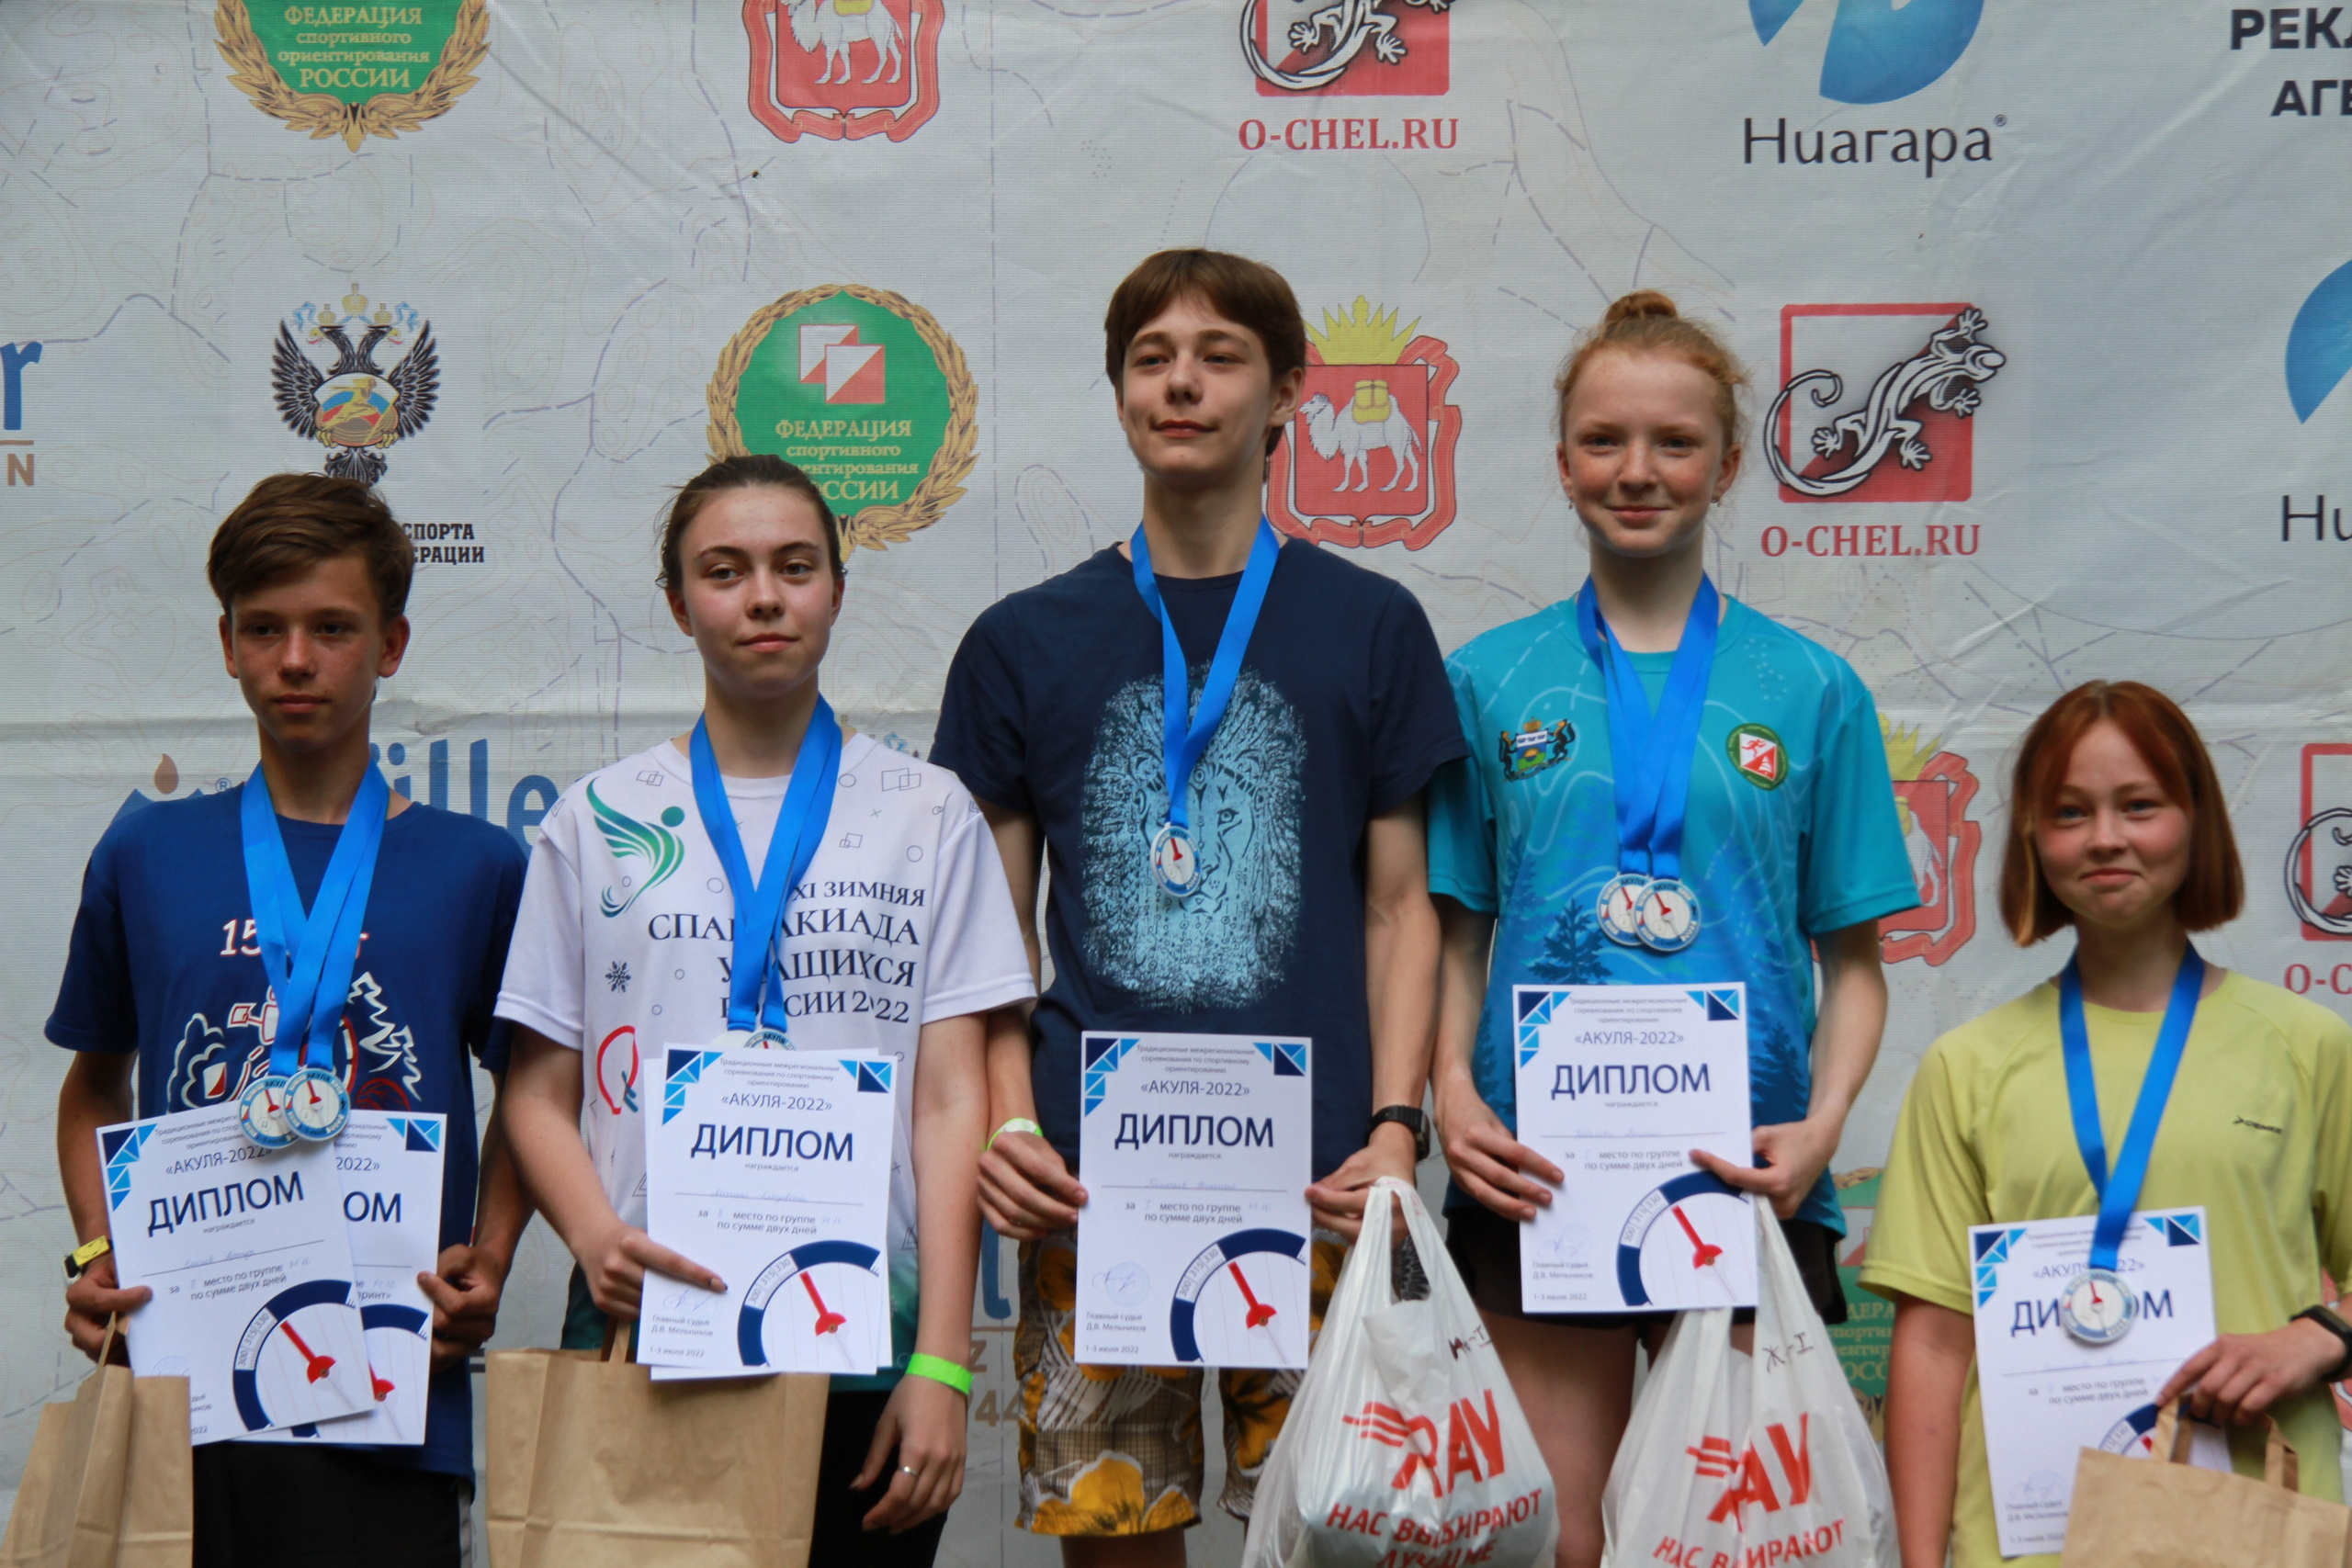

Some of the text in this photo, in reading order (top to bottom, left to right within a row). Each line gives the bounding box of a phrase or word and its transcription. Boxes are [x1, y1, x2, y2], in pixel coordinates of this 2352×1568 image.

[284, 6, 423, 28] ФЕДЕРАЦИЯ
[2230, 7, 2352, 50] РЕК
[295, 32, 412, 49] спортивного
[277, 49, 431, 65] ориентирования
[300, 68, 411, 89] РОССИИ
[1238, 118, 1459, 150] O-CHEL.RU
[1743, 118, 1994, 178] Ниагара
[775, 420, 912, 441] ФЕДЕРАЦИЯ
[786, 446, 901, 460] спортивного
[799, 463, 919, 479] ентирования
[401, 523, 475, 540] СПОРТА
[1760, 524, 1981, 557] O-CHEL.RU
[823, 881, 926, 907] ЗИМНЯЯ
[1575, 1031, 1684, 1045] «АКУЛЯ-2022»
[1141, 1079, 1250, 1097] «АКУЛЯ-2022»
[1551, 1064, 1711, 1100] ДИПЛОМ
[721, 1092, 833, 1111] «АКУЛЯ-2022»
[690, 1122, 854, 1162] ДИПЛОМ
[1114, 1113, 1274, 1150] ДИПЛОМ
[1565, 1151, 1575, 1159] за
[1599, 1151, 1630, 1159] место
[1631, 1151, 1644, 1159] по
[1645, 1150, 1680, 1160] группе
[1584, 1159, 1683, 1171] по сумме двух дней
[147, 1171, 304, 1237] ДИПЛОМ
[343, 1190, 402, 1223] ОМ
[1125, 1202, 1241, 1213] за место по группе
[697, 1209, 708, 1217] за
[733, 1211, 763, 1222] место
[764, 1213, 778, 1222] по
[780, 1213, 816, 1225] группе
[1144, 1213, 1243, 1224] по сумме двух дней
[717, 1221, 817, 1235] по сумме двух дней
[203, 1274, 233, 1288] место
[249, 1264, 283, 1280] группе
[205, 1286, 237, 1300] сумме
[238, 1280, 261, 1294] двух
[262, 1273, 288, 1288] дней
[1326, 1503, 1389, 1536] НАС
